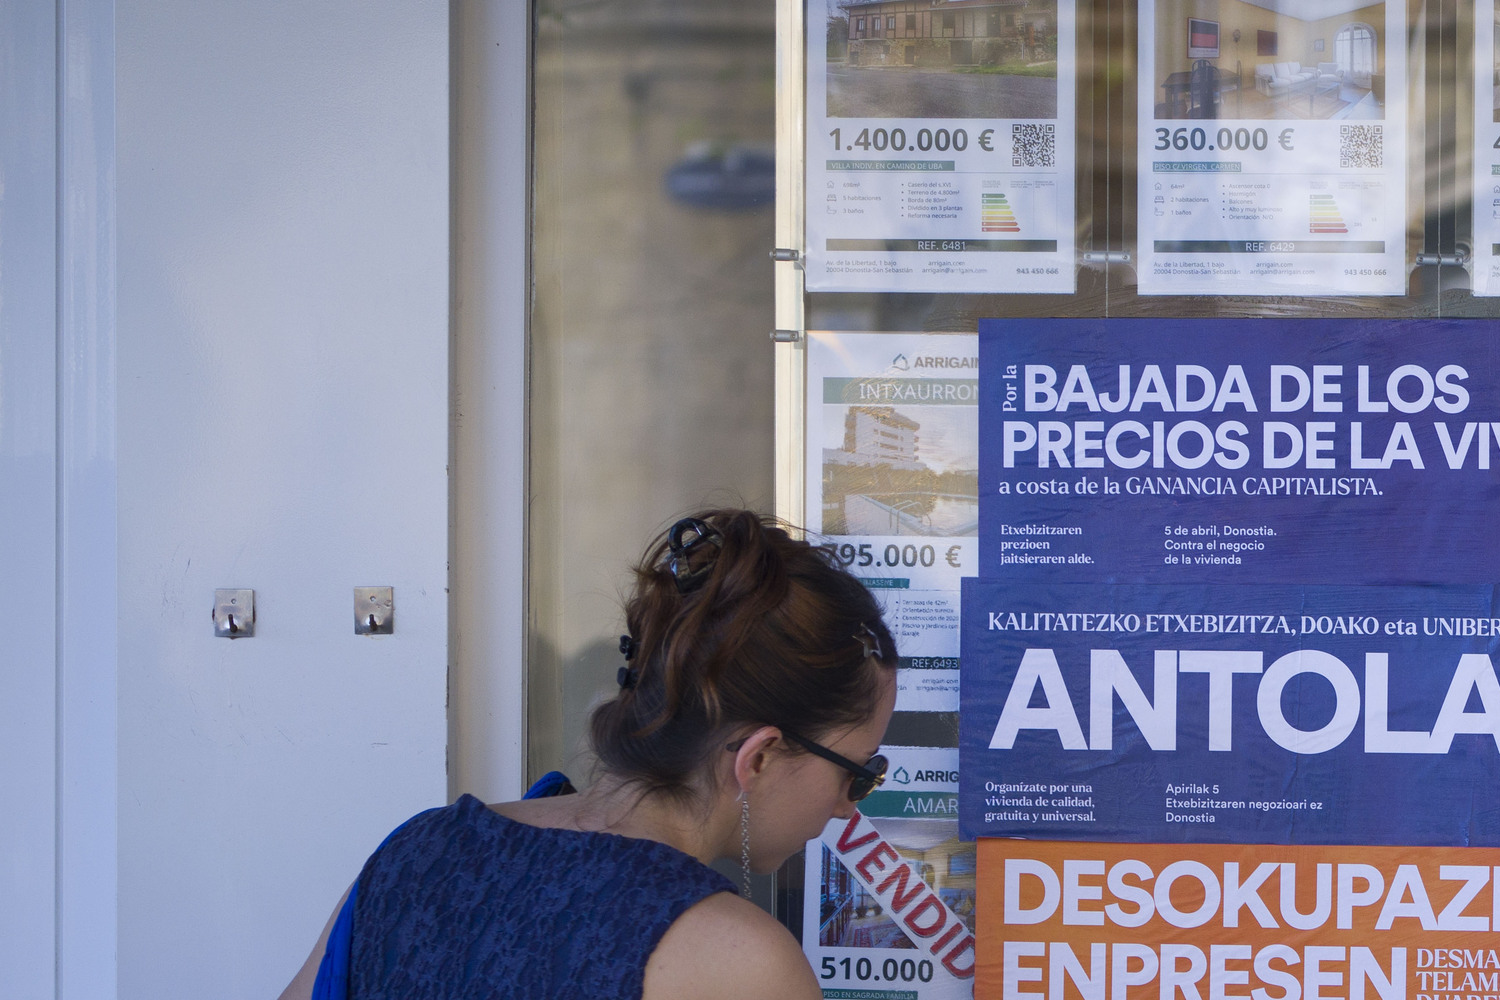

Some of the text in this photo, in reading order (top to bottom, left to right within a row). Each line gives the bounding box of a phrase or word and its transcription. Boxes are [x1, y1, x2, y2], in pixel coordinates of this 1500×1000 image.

[830, 128, 994, 151] 1.400.000 €
[1155, 128, 1294, 150] 360.000 €
[918, 241, 965, 250] REF. 6481
[1245, 241, 1294, 252] REF. 6429
[1003, 365, 1016, 411] Por la
[1025, 365, 1469, 413] BAJADA DE LOS
[1004, 421, 1249, 469] PRECIOS
[1263, 422, 1335, 469] DE
[1351, 422, 1425, 469] LA
[999, 477, 1383, 495] a costa de la GANANCIA CAPITALISTA.
[1001, 525, 1082, 534] Etxebizitzaren
[1165, 525, 1276, 537] 5 de abril, Donostia.
[1001, 539, 1049, 551] prezioen
[1001, 553, 1094, 565] jaitsieraren alde.
[989, 613, 1140, 632] KALITATEZKO
[1146, 615, 1296, 636] ETXEBIZITZA,
[1301, 616, 1379, 634] DOAKO
[1385, 619, 1417, 635] eta
[986, 782, 1047, 794] Organízate
[1050, 785, 1067, 794] por
[985, 796, 1094, 807] vivienda de calidad,
[985, 810, 1095, 823] gratuita y universal.
[821, 957, 933, 982] 510.000
